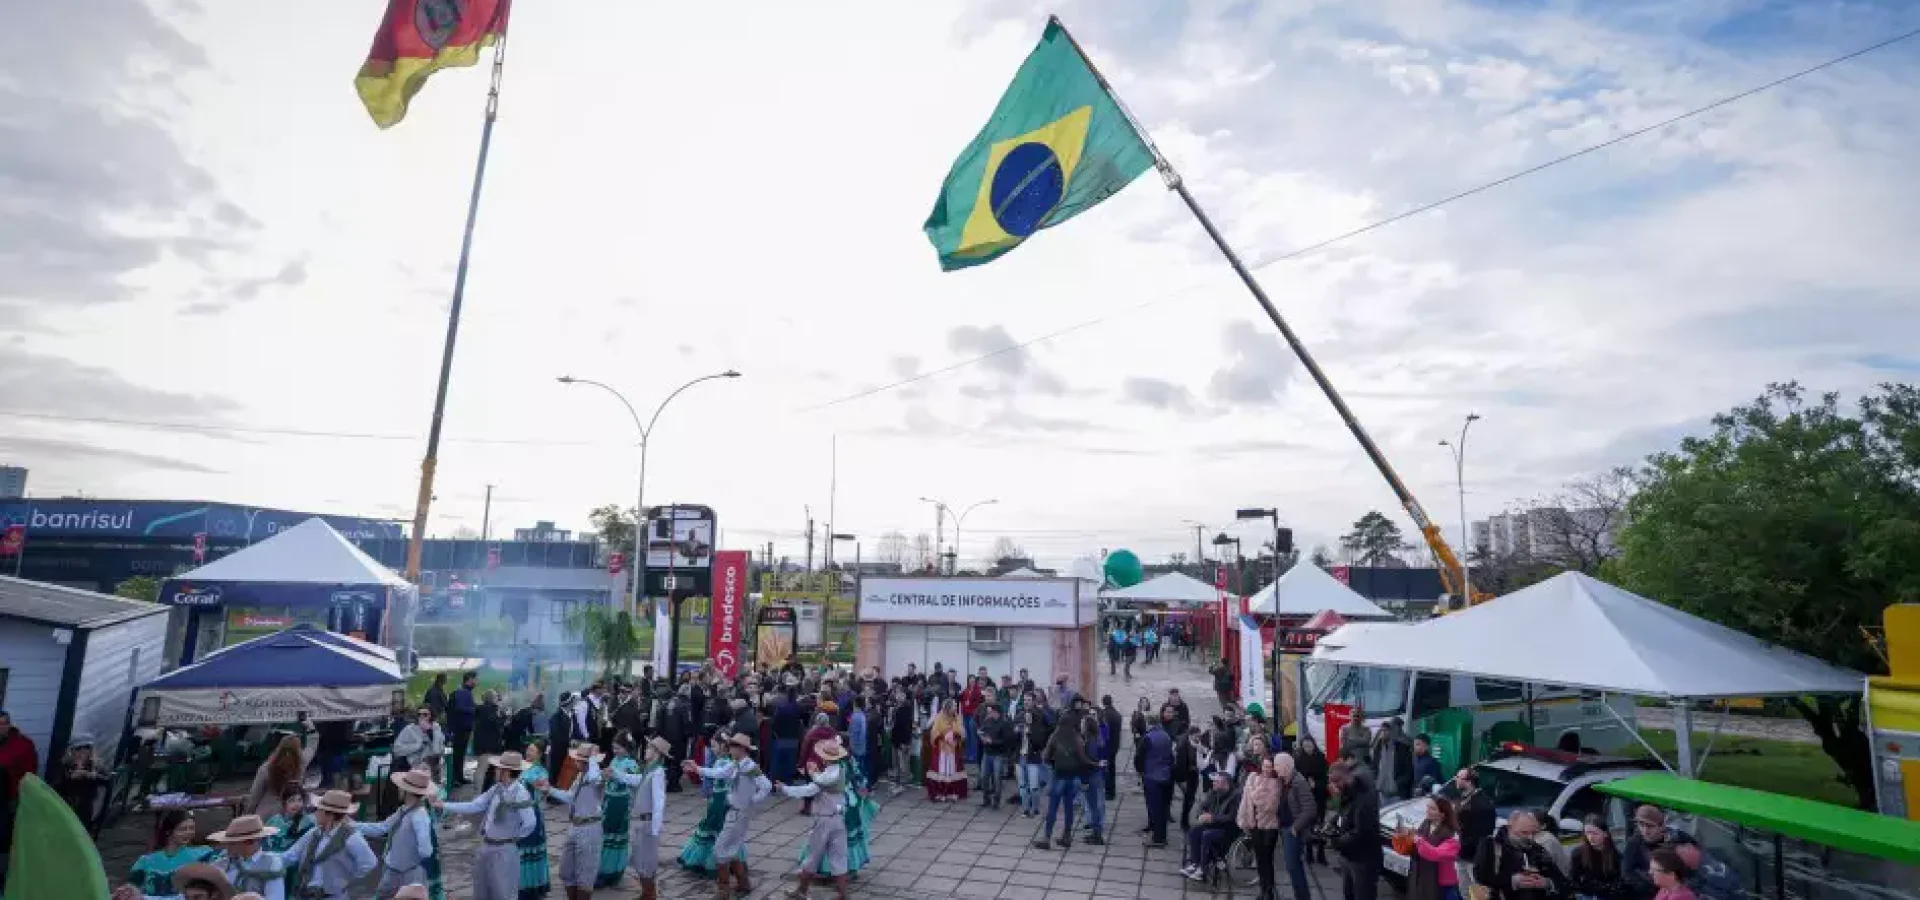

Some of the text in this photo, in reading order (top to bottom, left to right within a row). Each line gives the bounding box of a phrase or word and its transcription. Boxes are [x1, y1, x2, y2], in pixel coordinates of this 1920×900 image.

[31, 508, 133, 529] banrisul
[721, 566, 737, 643] bradesco
[890, 593, 939, 607] CENTRAL
[942, 594, 956, 607] DE
[958, 593, 1041, 611] INFORMAÇÕES
